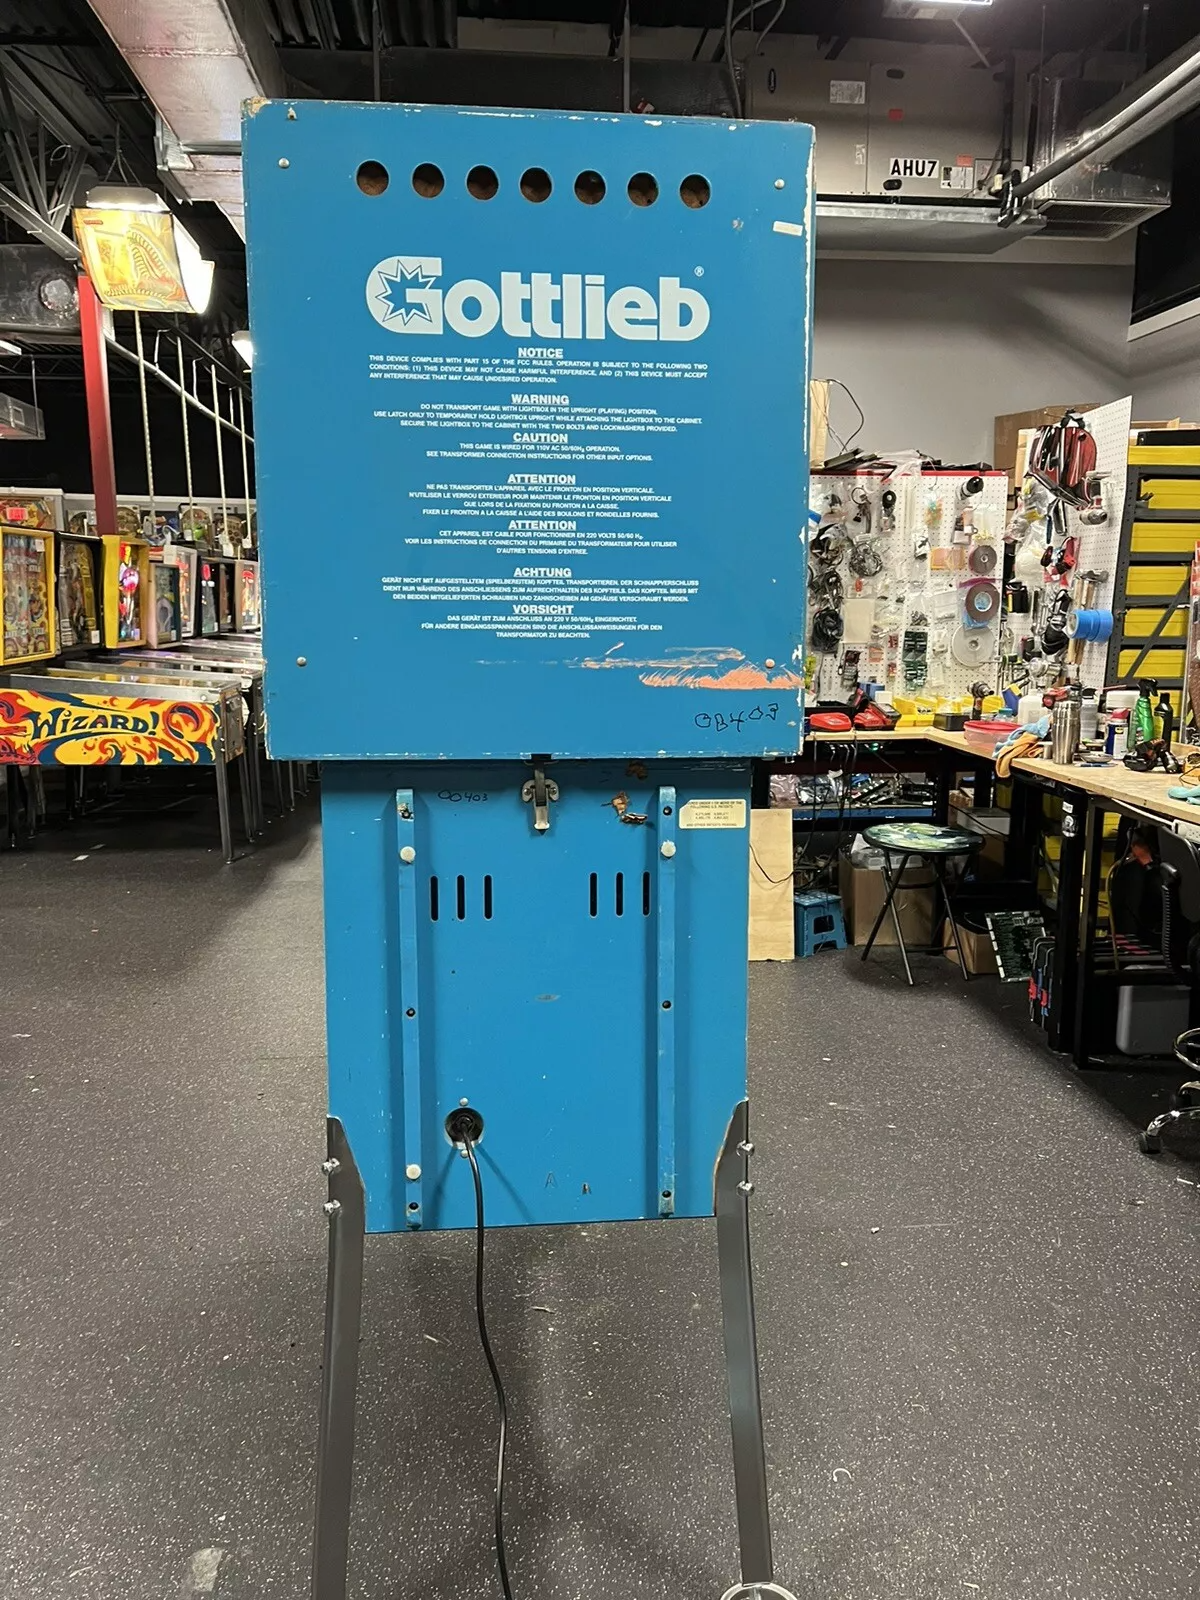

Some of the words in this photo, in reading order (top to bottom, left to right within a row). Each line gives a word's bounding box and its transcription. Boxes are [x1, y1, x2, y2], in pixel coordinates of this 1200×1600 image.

[891, 159, 938, 177] AHU7
[366, 256, 710, 341] Gottlieb
[518, 347, 562, 358] NOTICE
[511, 394, 568, 405] WARNING
[513, 432, 567, 443] CAUTION
[507, 474, 575, 484] ATTENTION
[508, 520, 575, 530] ATTENTION
[513, 567, 571, 577] ACHTUNG
[512, 604, 573, 614] VORSICHT
